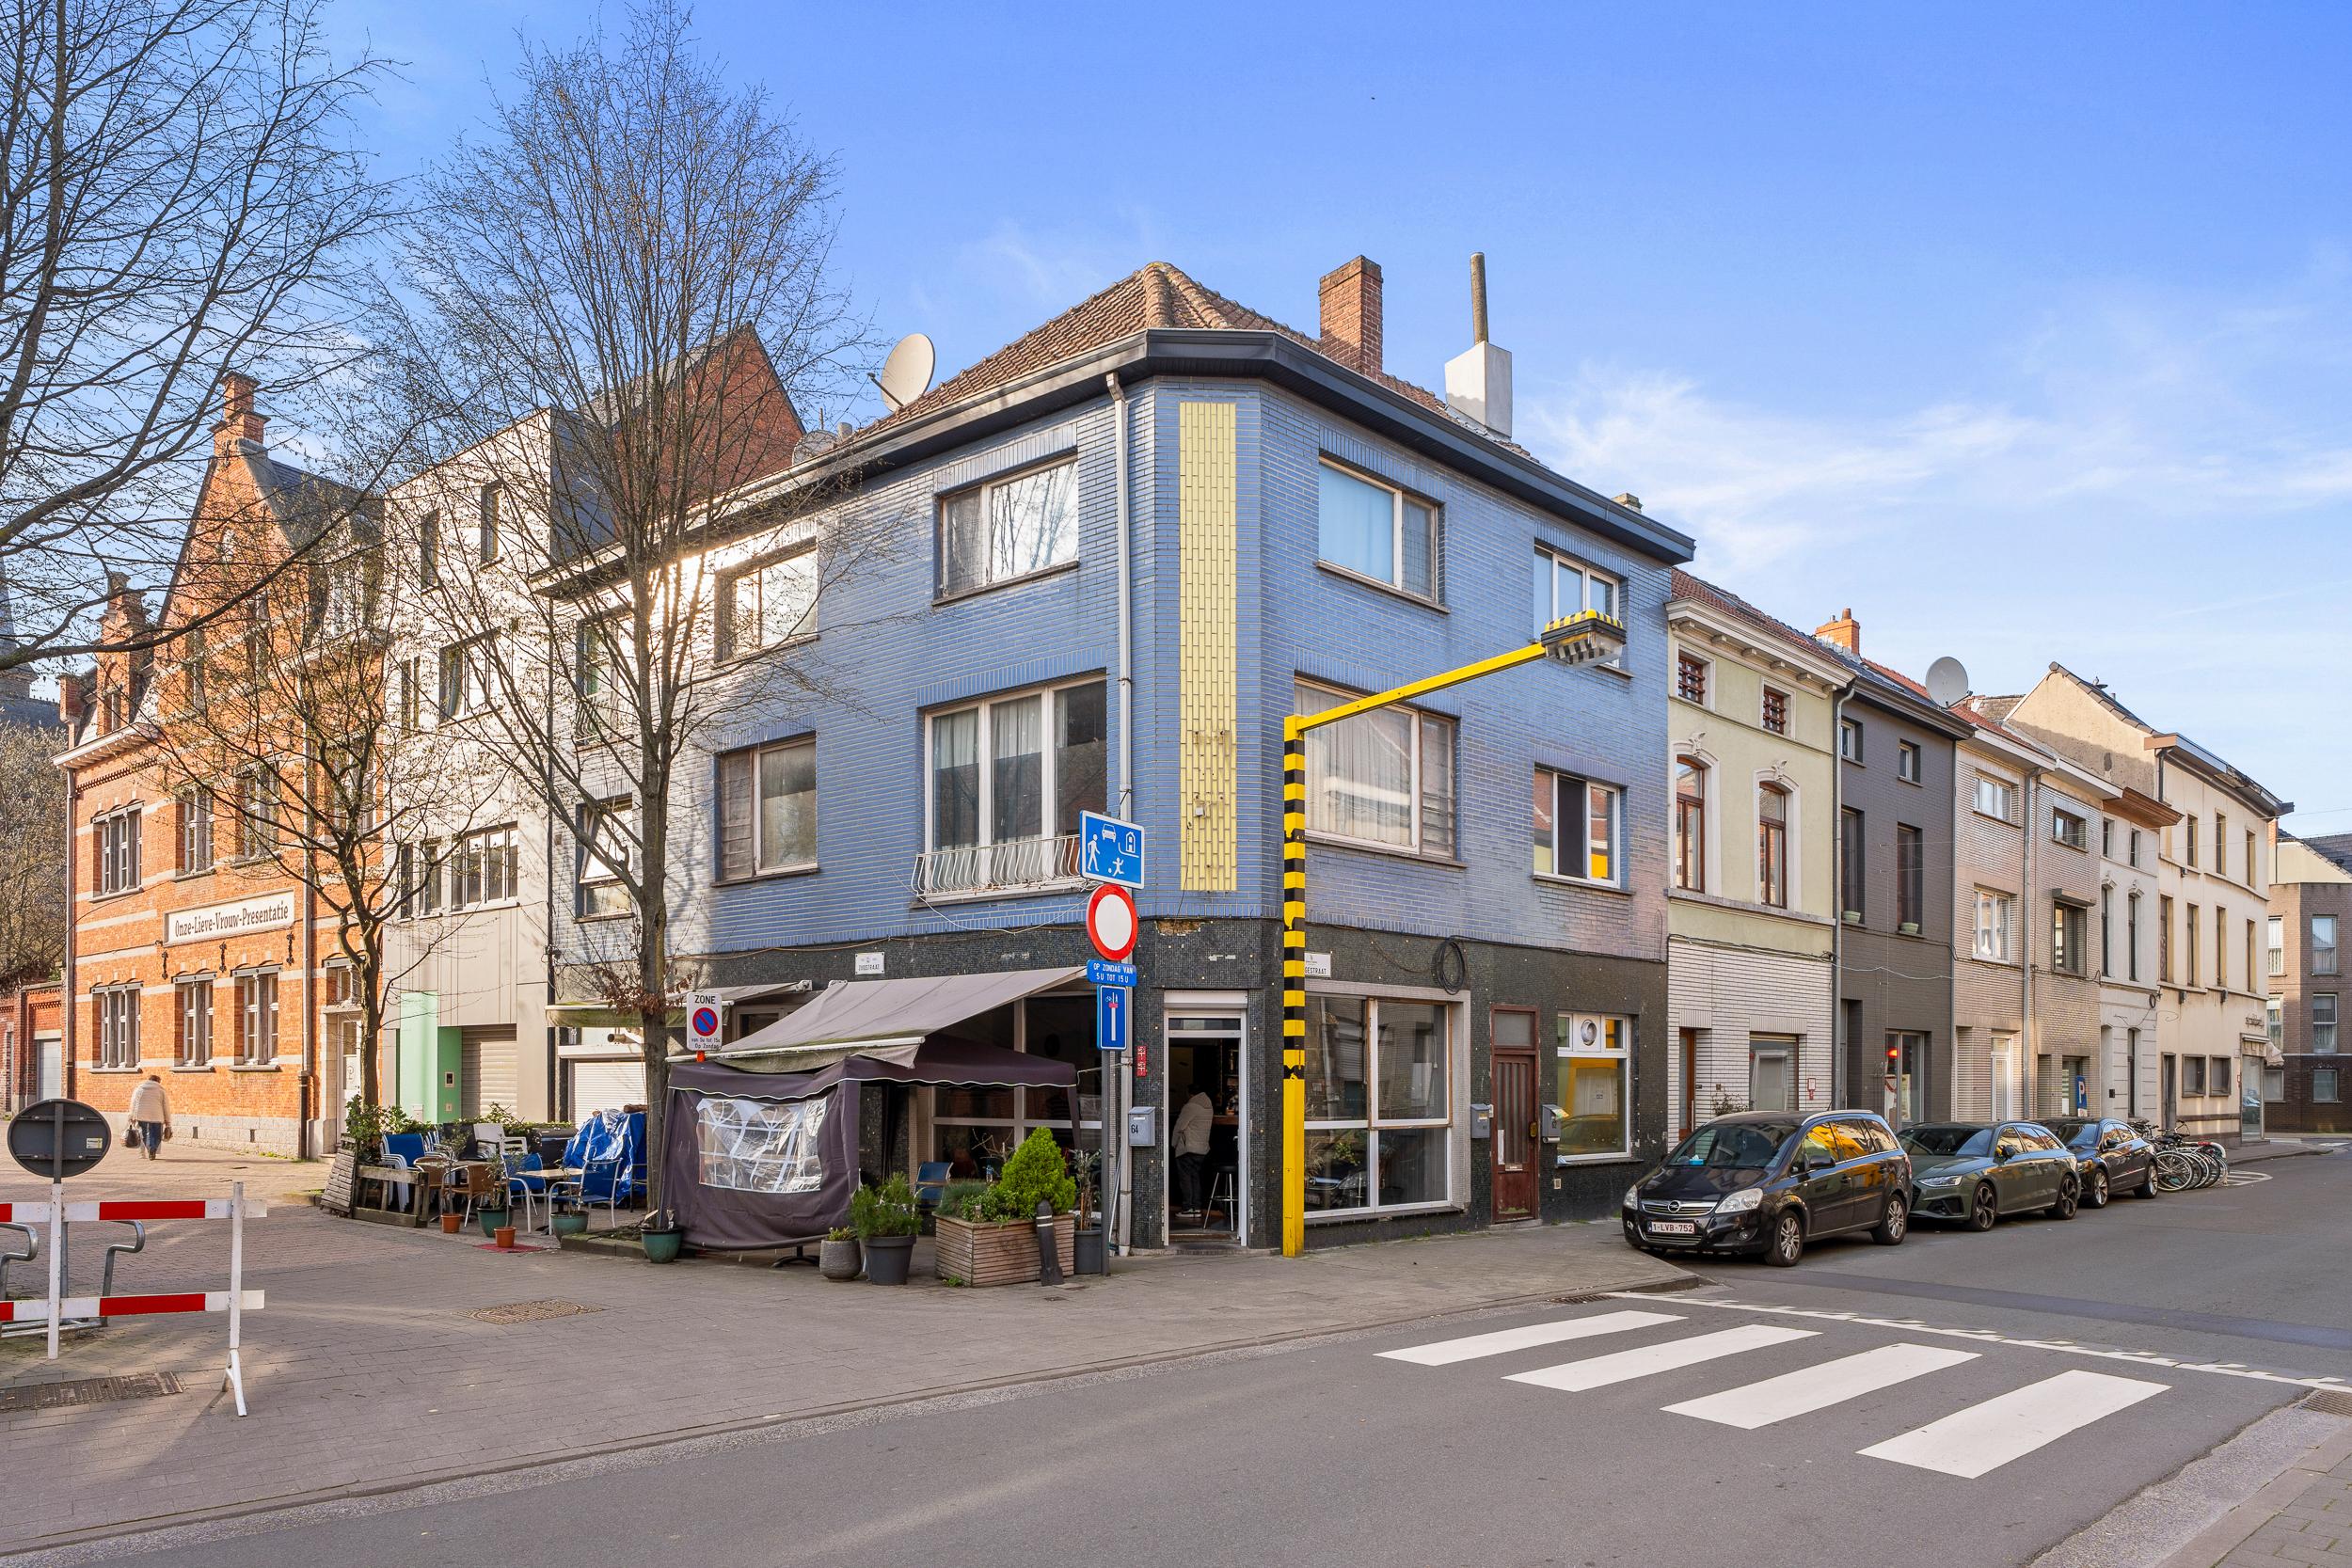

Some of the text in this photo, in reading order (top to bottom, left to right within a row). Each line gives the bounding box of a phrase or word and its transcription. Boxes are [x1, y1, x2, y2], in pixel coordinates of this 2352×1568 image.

[174, 901, 289, 937] Onze-Lieve-Vrouw-Presentatie
[1103, 964, 1121, 973] ZONDAG
[1123, 966, 1134, 974] VAN
[1305, 966, 1327, 974] GESTRAAT
[694, 995, 716, 1005] ZONE
[2078, 1081, 2086, 1104] P
[1131, 1124, 1138, 1134] 64
[1653, 1224, 1693, 1232] 1-LVB-752
